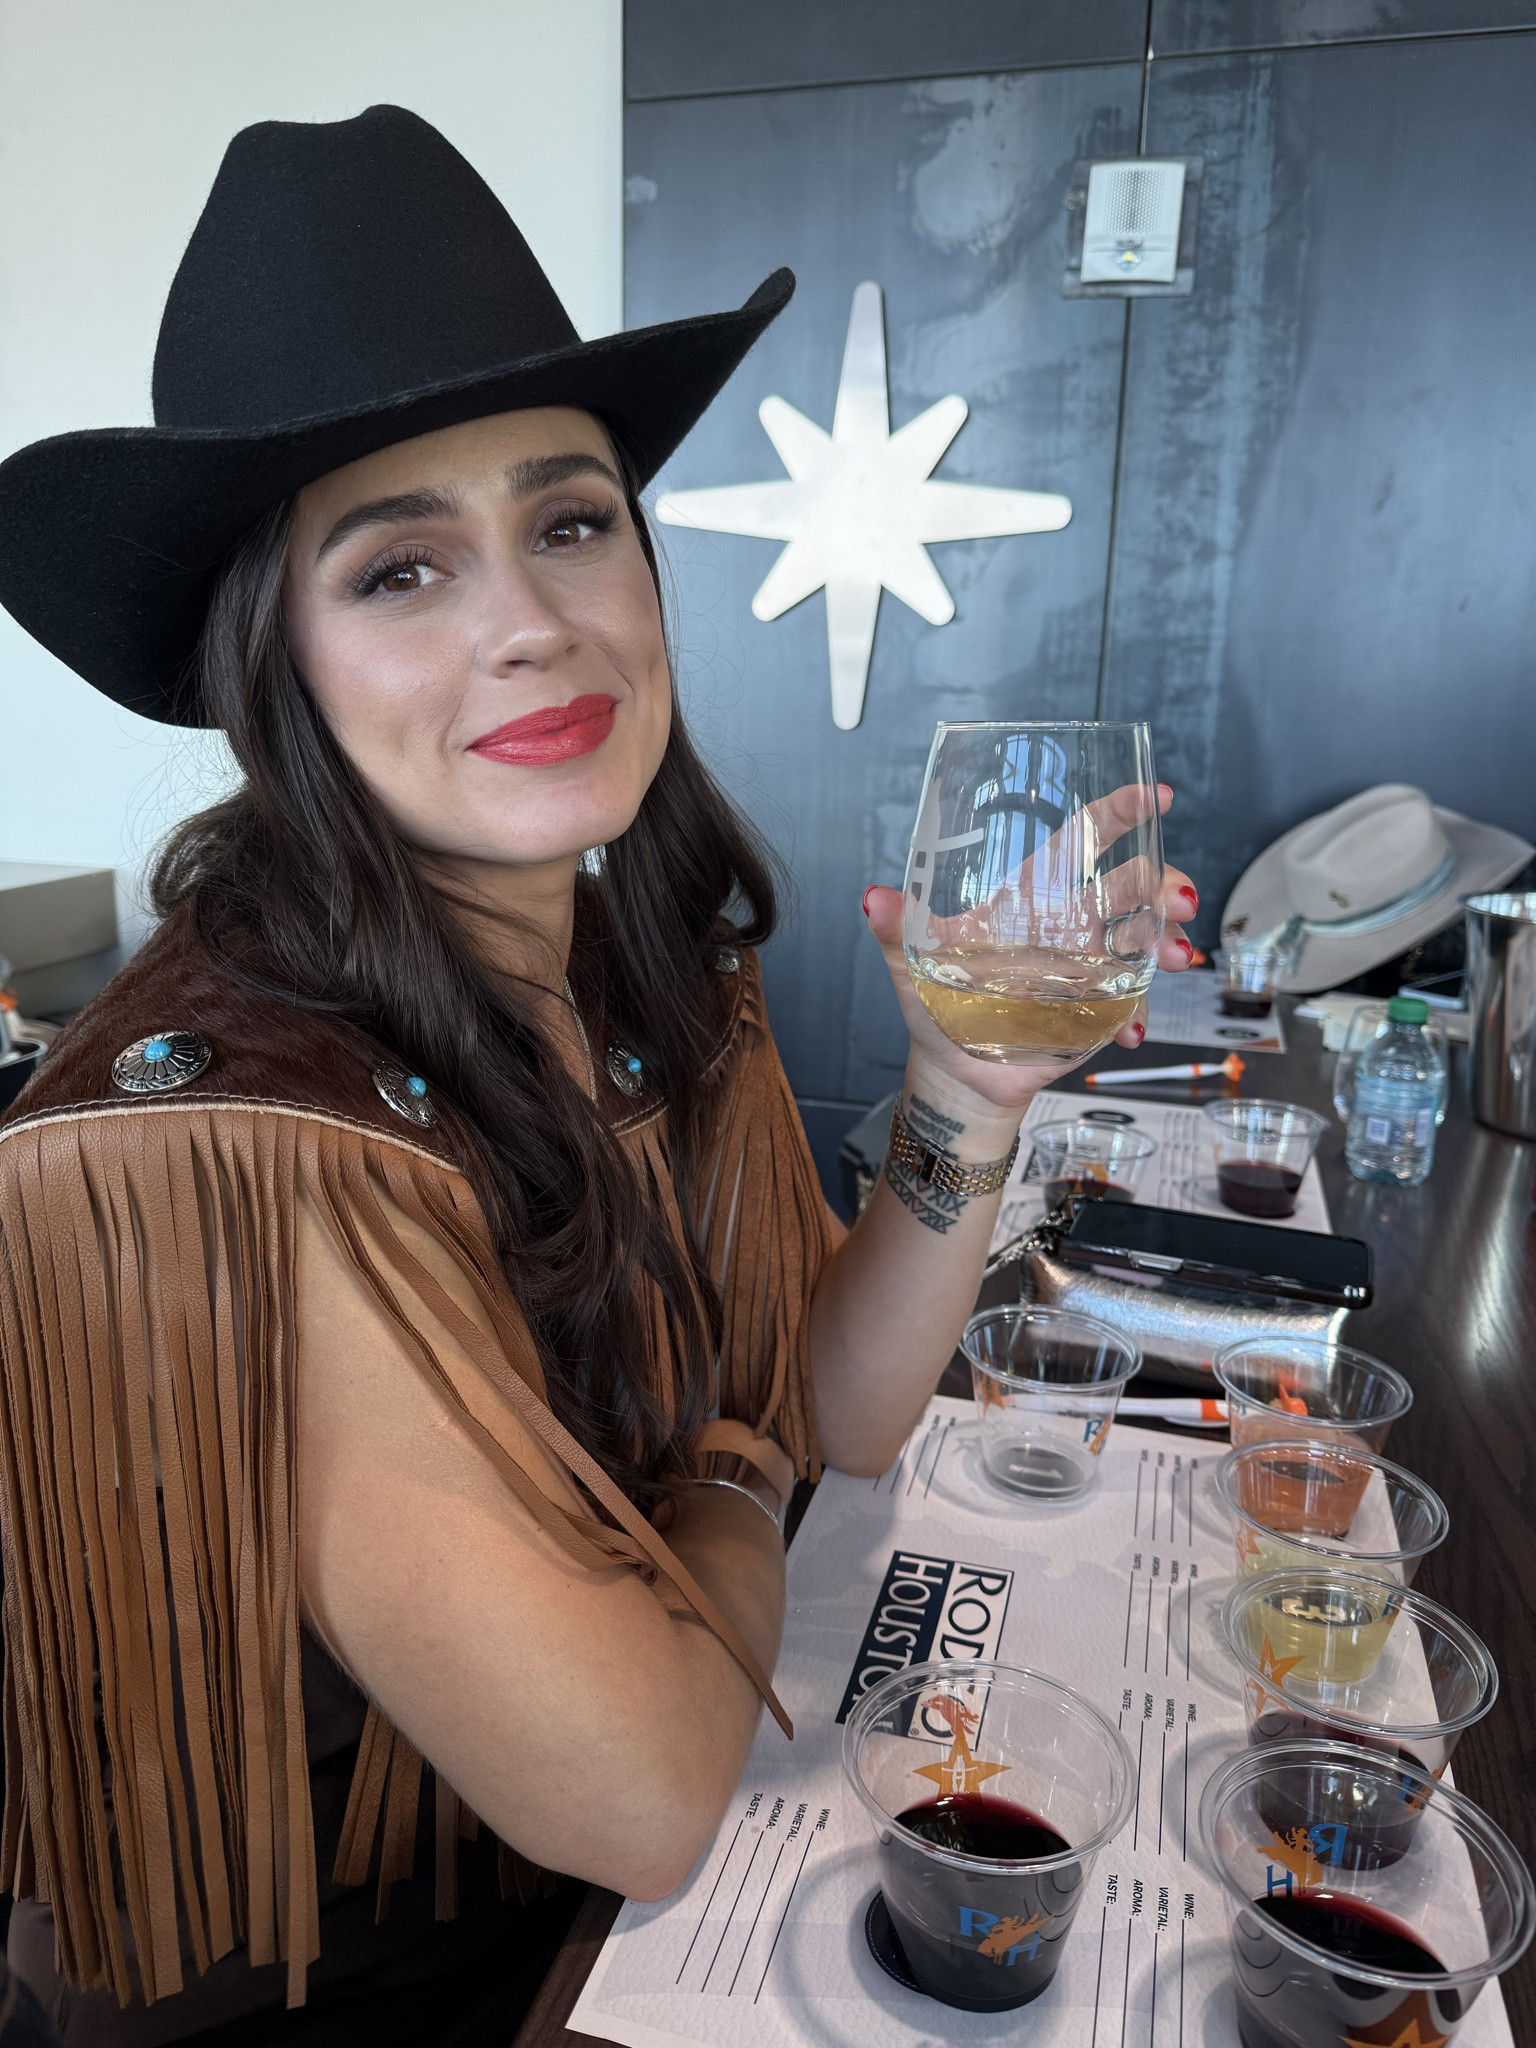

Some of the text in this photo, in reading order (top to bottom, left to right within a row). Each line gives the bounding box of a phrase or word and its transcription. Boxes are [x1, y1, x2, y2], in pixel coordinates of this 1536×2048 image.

[1144, 1692, 1153, 1720] AROMA:
[1165, 1699, 1174, 1731] VARIETAL:
[745, 1793, 763, 1818] TASTE:
[766, 1797, 785, 1829] AROMA:
[815, 1808, 831, 1831] WINE:
[786, 1803, 808, 1842] VARIETAL:
[1106, 1874, 1118, 1904] TASTE:
[1131, 1879, 1143, 1916] AROMA:
[1157, 1887, 1168, 1931] VARIETAL:
[1184, 1893, 1194, 1919] WINE:
